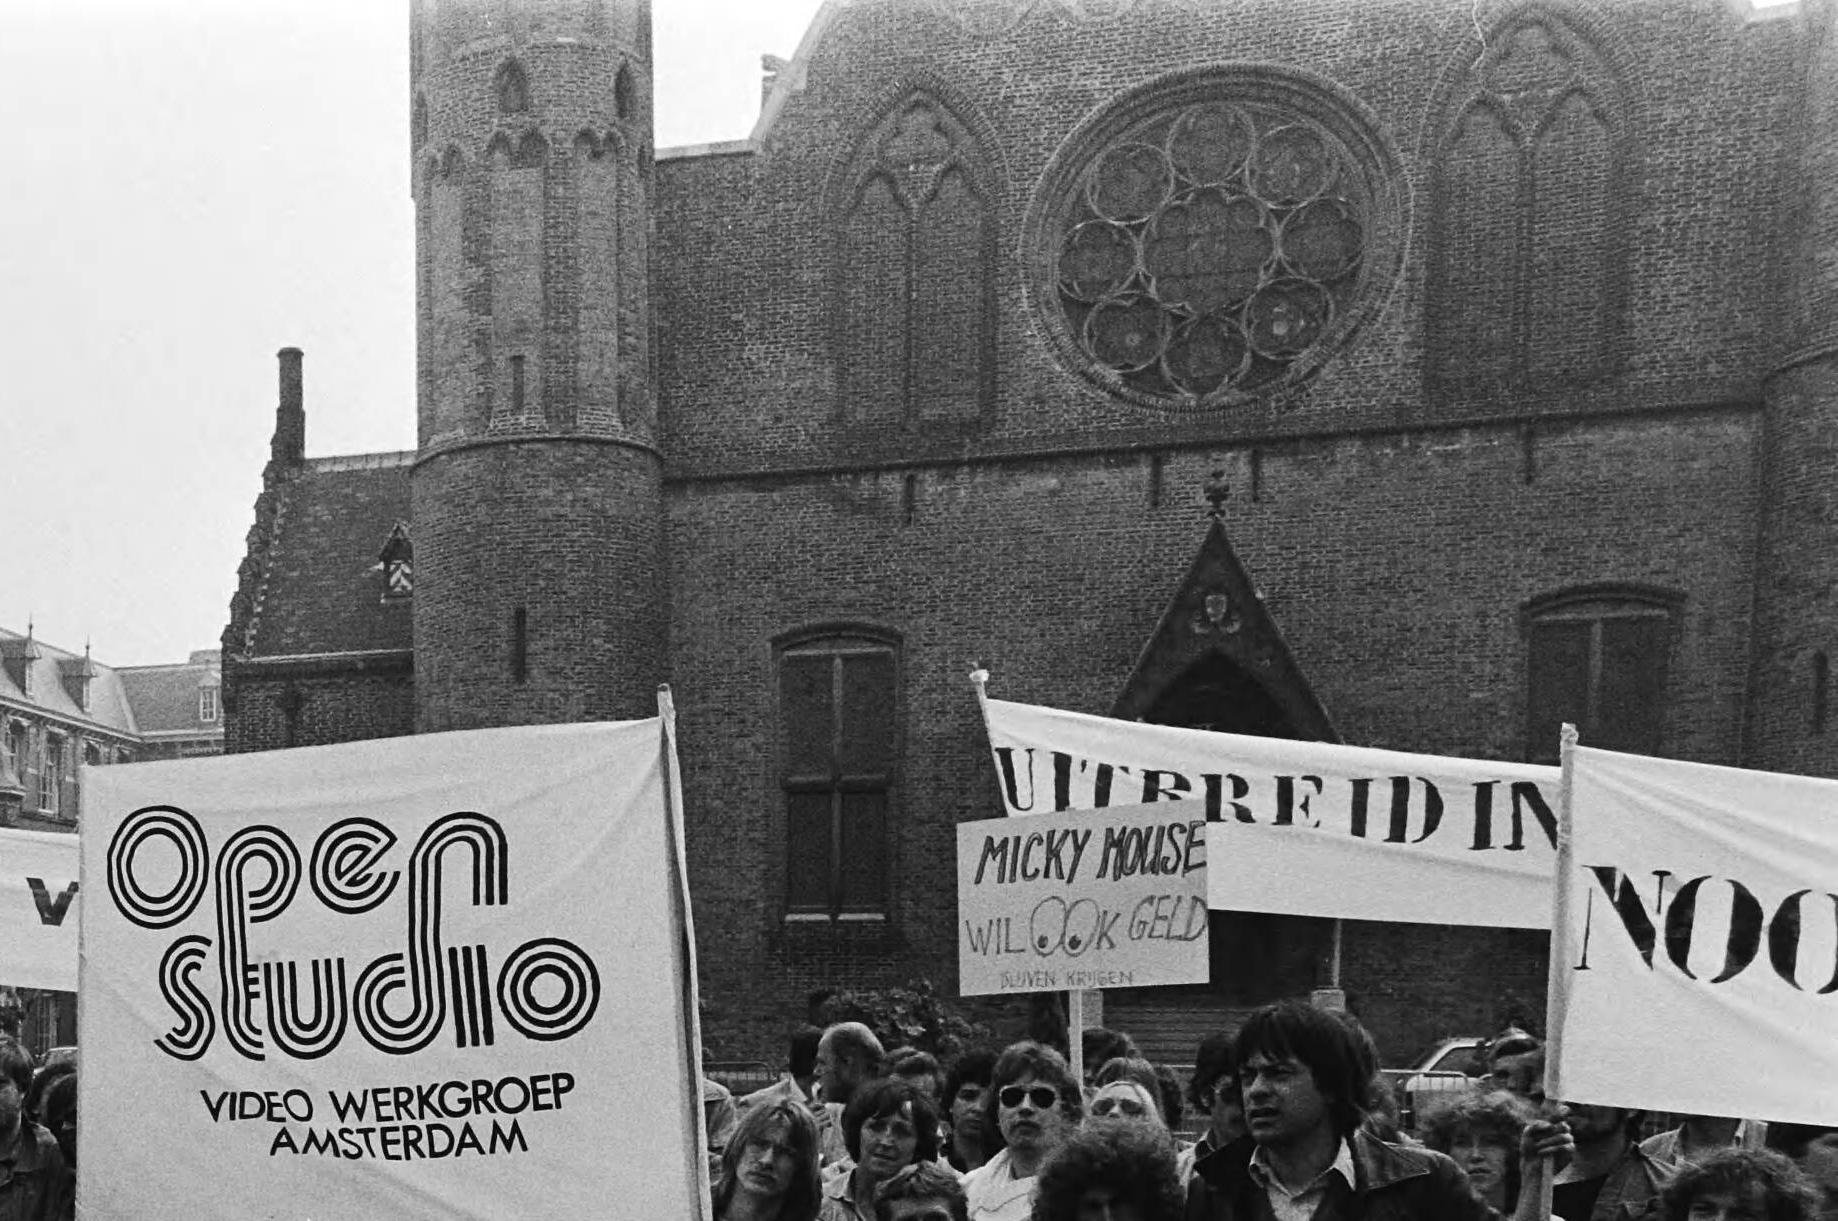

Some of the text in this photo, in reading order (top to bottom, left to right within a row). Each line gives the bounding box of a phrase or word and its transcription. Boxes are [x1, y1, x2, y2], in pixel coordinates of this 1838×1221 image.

[974, 820, 1207, 884] MICKY MOUSE
[26, 877, 79, 926] V
[965, 895, 1209, 958] WIL OOK GELD
[200, 1072, 575, 1123] VIDEO WERKGROEP
[270, 1119, 528, 1160] AMSTERDAM
